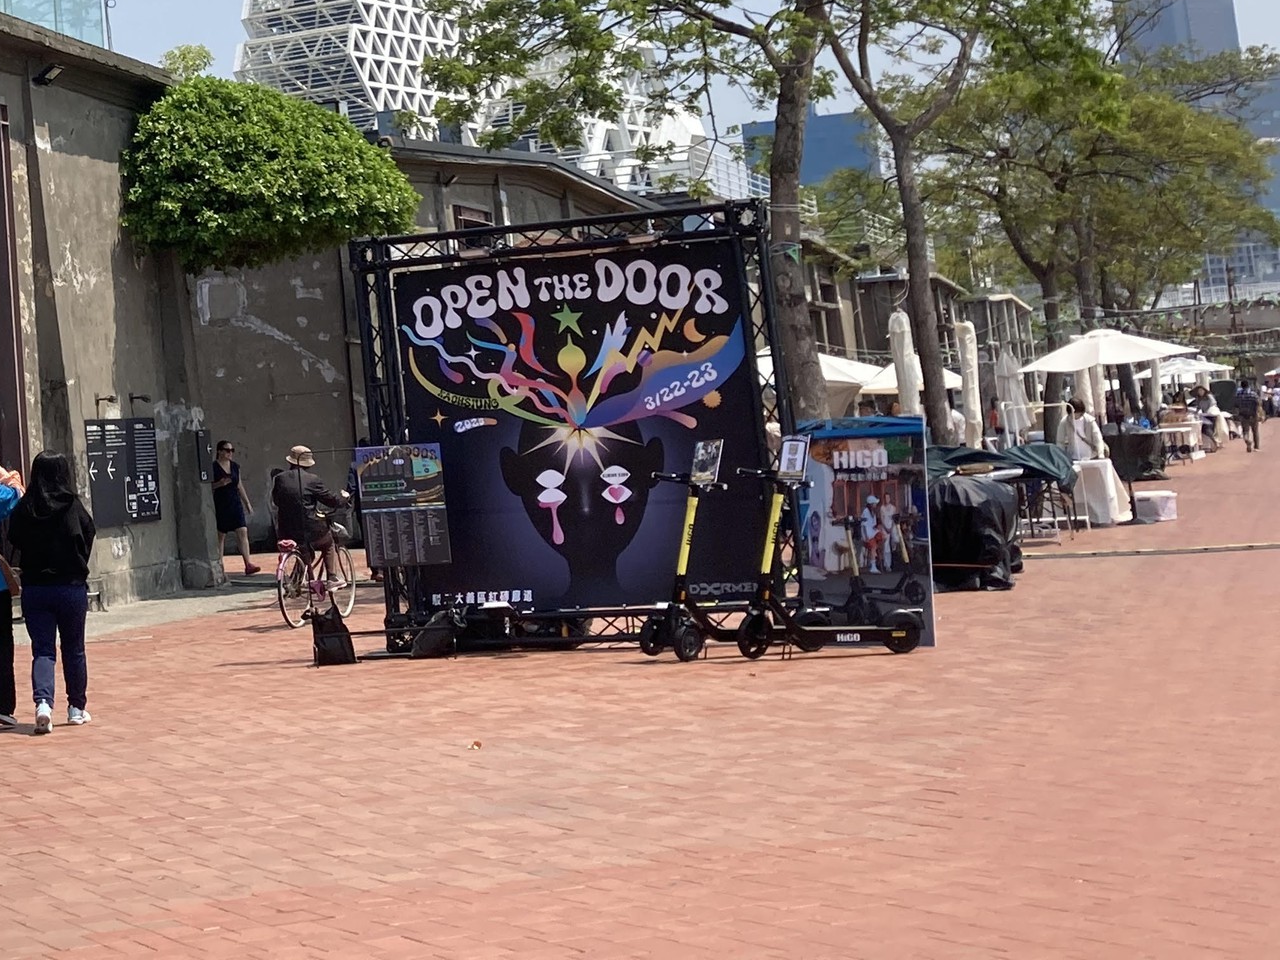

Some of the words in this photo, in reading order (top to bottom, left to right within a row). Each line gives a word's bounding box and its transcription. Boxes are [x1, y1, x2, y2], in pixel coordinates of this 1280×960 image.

[412, 266, 531, 339] OPEN
[534, 273, 592, 302] THE
[594, 258, 729, 315] DOOR
[644, 362, 718, 410] 3/22-23
[833, 449, 888, 469] HIGO
